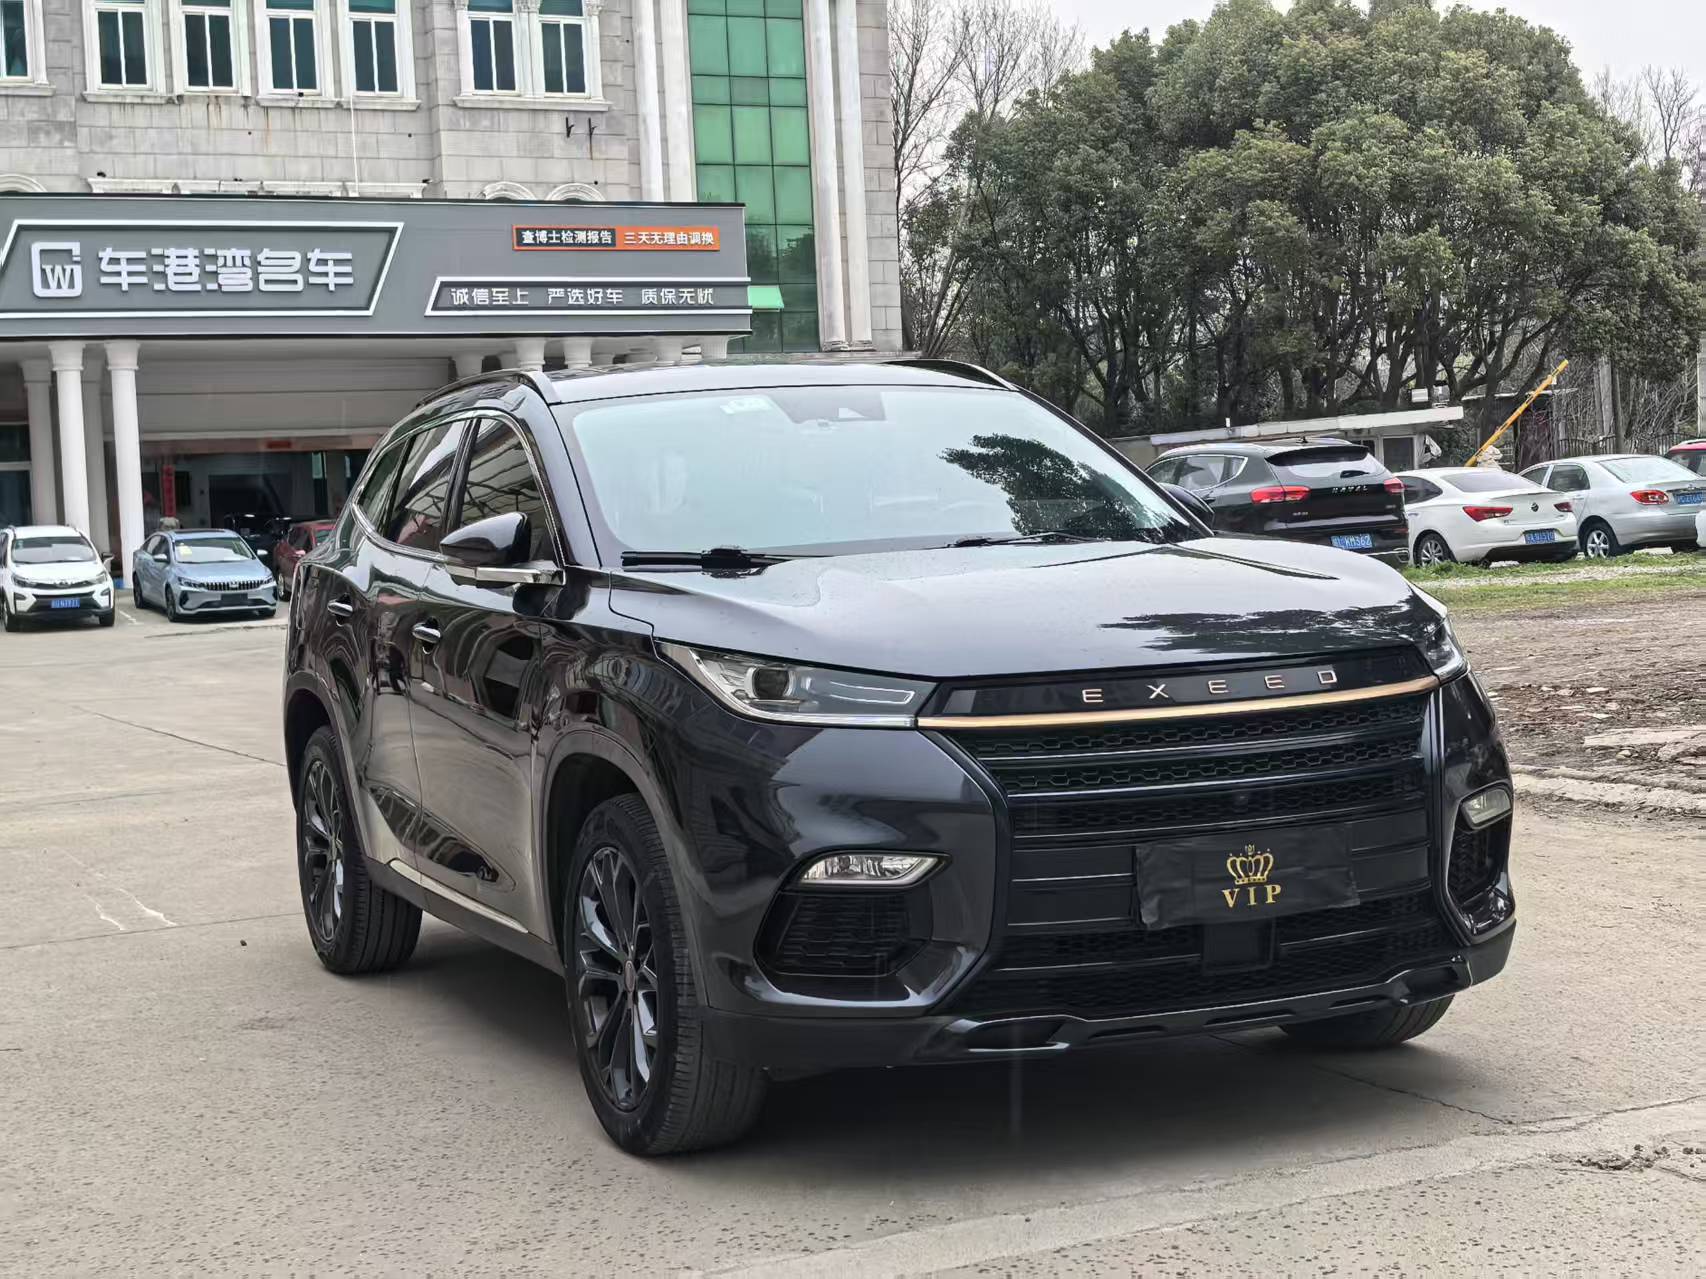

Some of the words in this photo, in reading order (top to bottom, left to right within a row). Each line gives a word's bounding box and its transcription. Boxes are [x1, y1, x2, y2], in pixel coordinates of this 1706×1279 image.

[521, 230, 613, 244] 查博士检测报告
[623, 231, 715, 245] 三天无理由调换
[98, 247, 354, 292] 车港湾名车
[450, 287, 529, 305] 诚信至上
[547, 287, 624, 305] 严选好车
[641, 287, 714, 305] 质保无忧
[1081, 669, 1339, 704] EXEED
[1221, 884, 1282, 908] VIP
